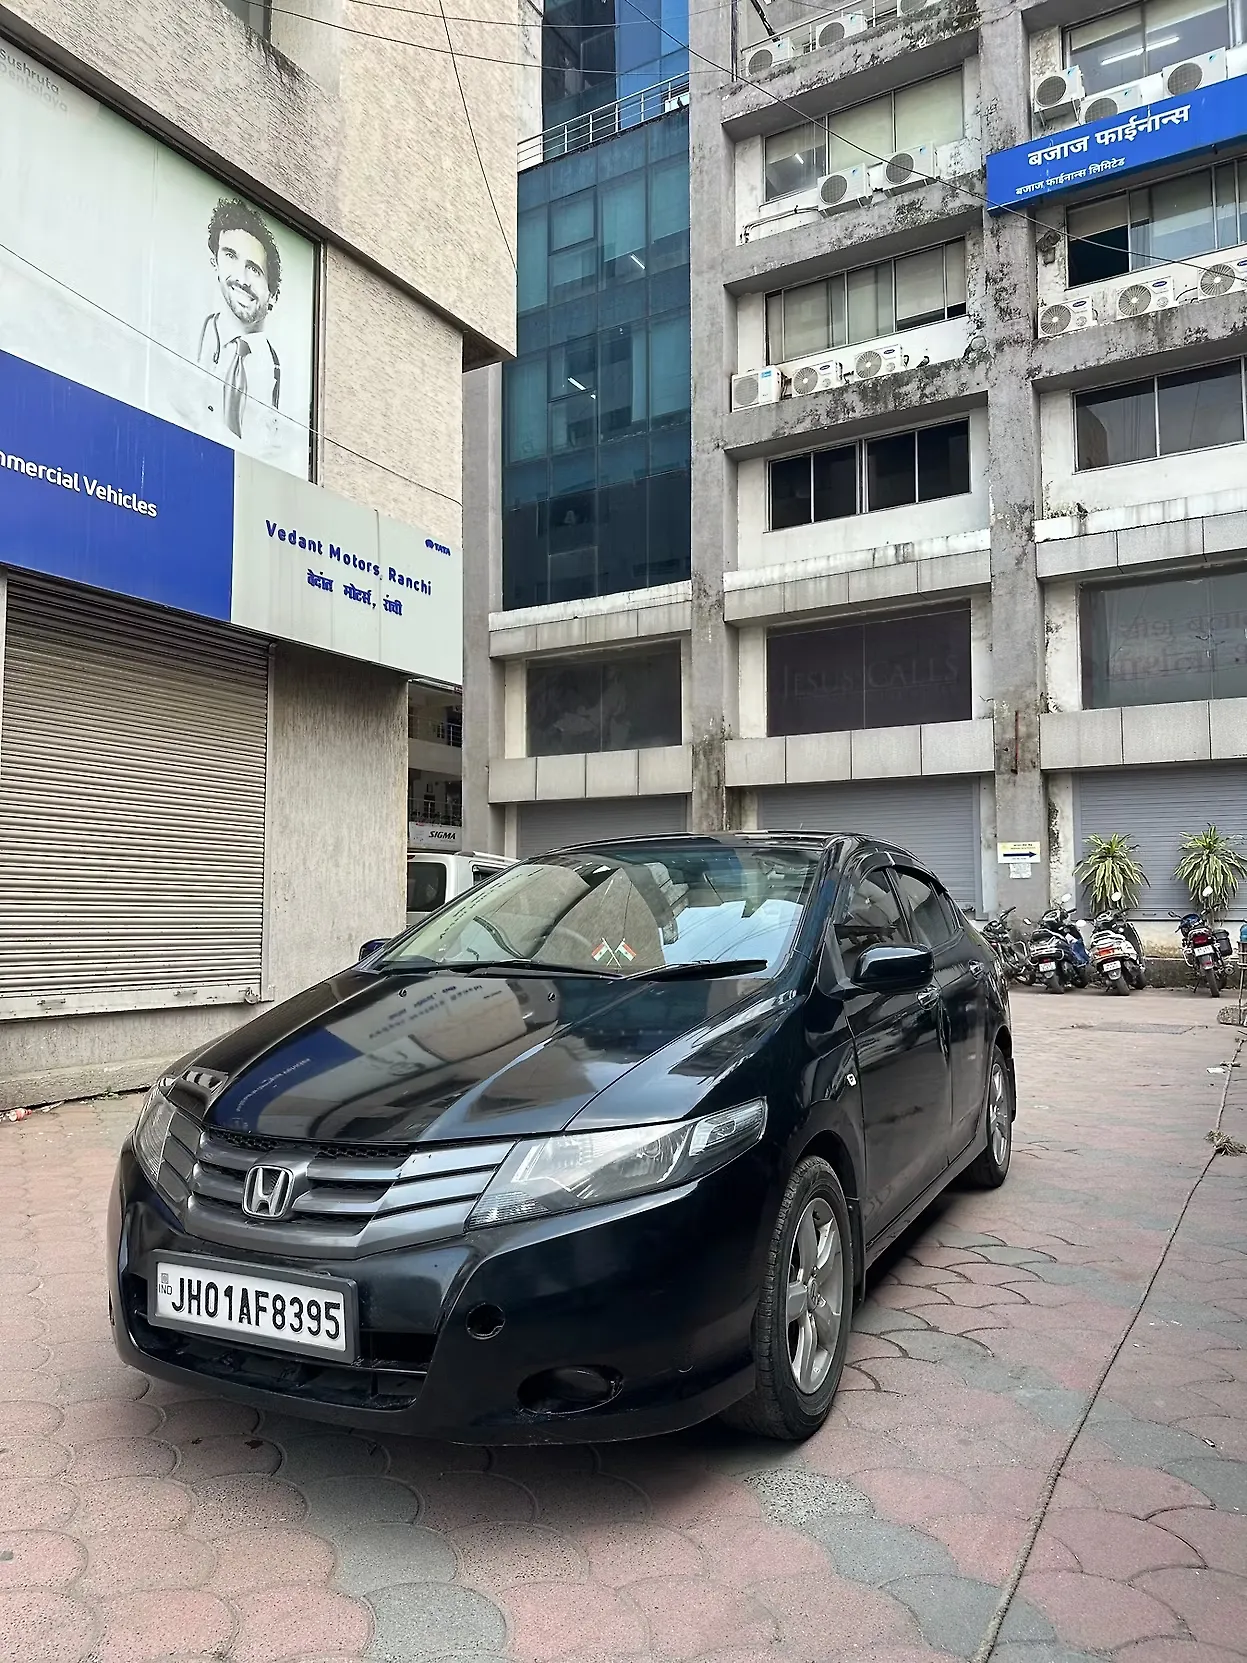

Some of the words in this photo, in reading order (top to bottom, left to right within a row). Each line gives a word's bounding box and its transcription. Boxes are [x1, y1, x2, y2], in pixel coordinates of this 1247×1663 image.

[1028, 136, 1090, 166] बजाज
[1095, 104, 1191, 147] फाईनान्स
[1015, 180, 1045, 196] बजाज
[1046, 168, 1087, 187] फाईनान्स
[1089, 157, 1126, 176] लिमिटेड
[83, 476, 158, 518] Vehicles
[266, 519, 323, 555] Vedant
[388, 567, 432, 596] Ranchi
[434, 542, 451, 556] TATA
[307, 569, 334, 592] वेदांत
[383, 594, 403, 616] रांची
[428, 830, 456, 840] SIGMA
[158, 1283, 173, 1296] IND
[171, 1276, 341, 1340] JH01AF8395
